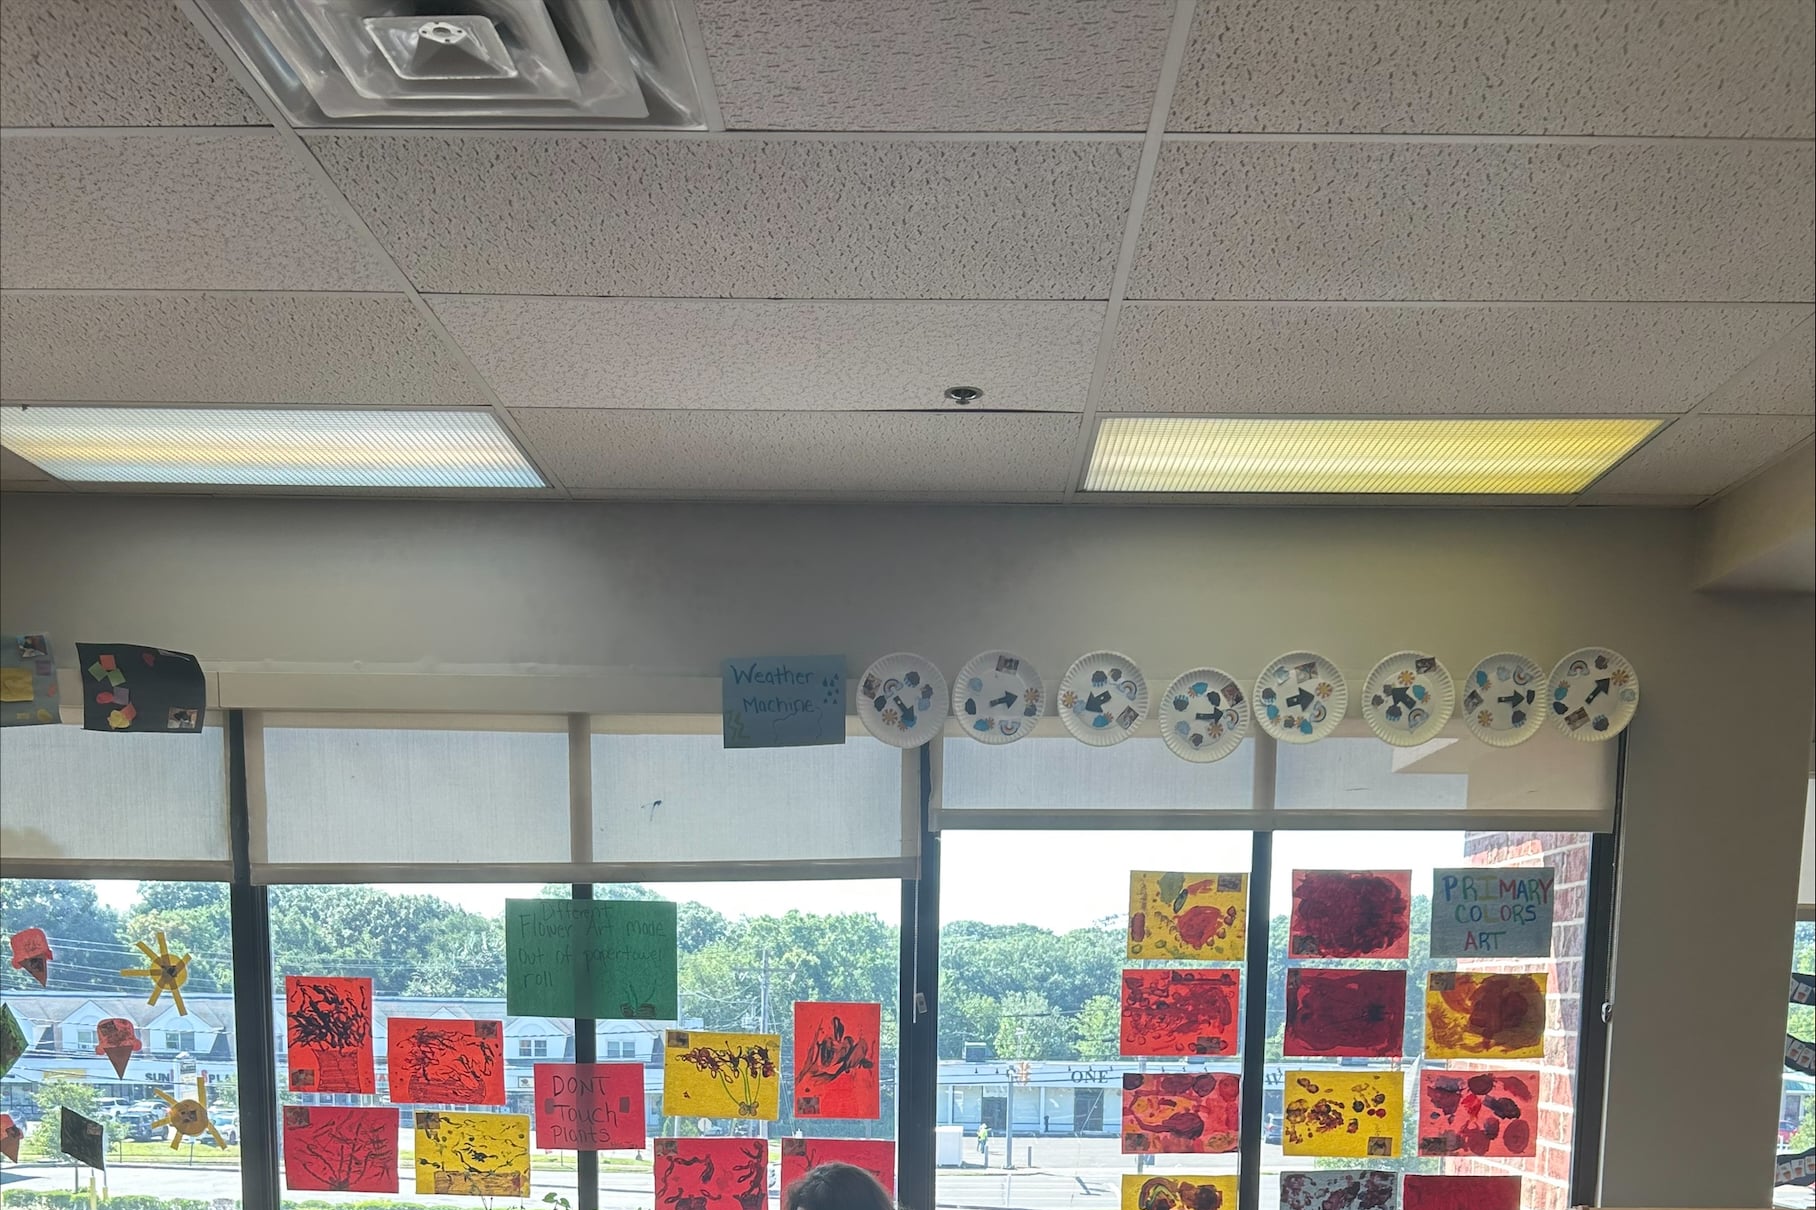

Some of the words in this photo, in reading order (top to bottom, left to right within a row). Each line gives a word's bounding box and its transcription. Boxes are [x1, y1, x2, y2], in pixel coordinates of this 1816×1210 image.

[730, 663, 814, 686] Weather
[743, 697, 815, 714] Machine
[1442, 875, 1554, 905] PRIMARY
[541, 901, 613, 922] Different
[1455, 904, 1537, 925] COLORS
[519, 911, 573, 938] Flower
[585, 918, 614, 937] Art
[1464, 931, 1507, 951] ART
[523, 970, 553, 989] roll
[552, 1075, 612, 1097] DONT
[1071, 1070, 1108, 1083] ONE
[552, 1101, 618, 1128] Touch
[550, 1125, 612, 1145] Plants
